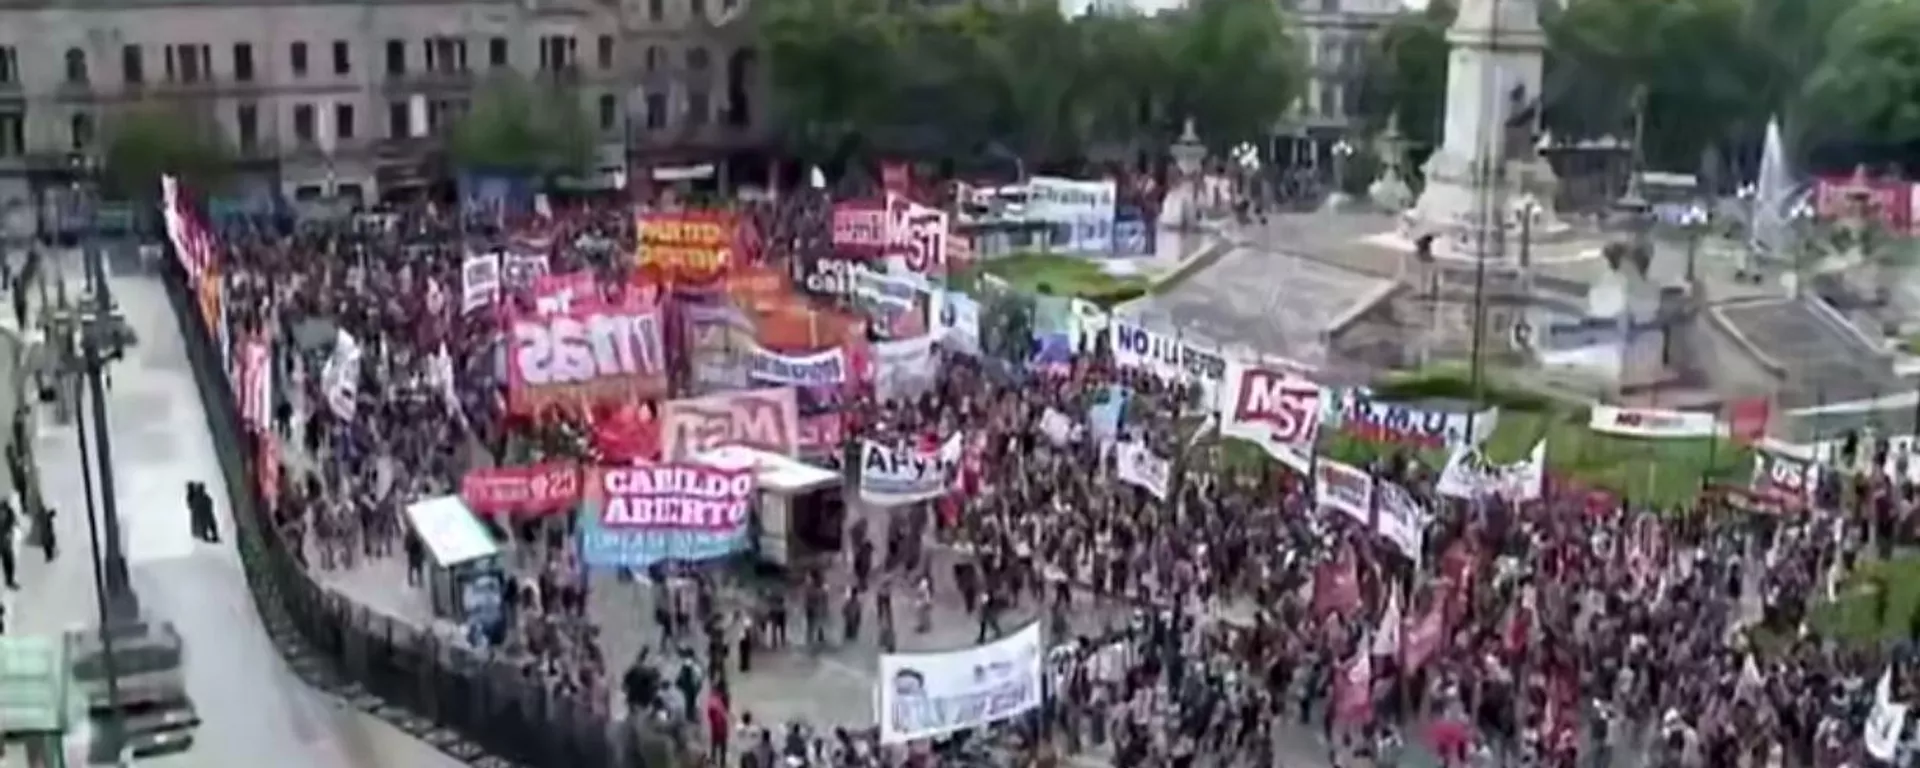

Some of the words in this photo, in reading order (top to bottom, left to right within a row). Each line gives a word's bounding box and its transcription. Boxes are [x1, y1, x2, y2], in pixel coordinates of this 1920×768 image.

[886, 200, 945, 272] MST
[1118, 325, 1149, 355] NO
[1235, 369, 1318, 443] MST
[605, 467, 750, 498] CABILDO
